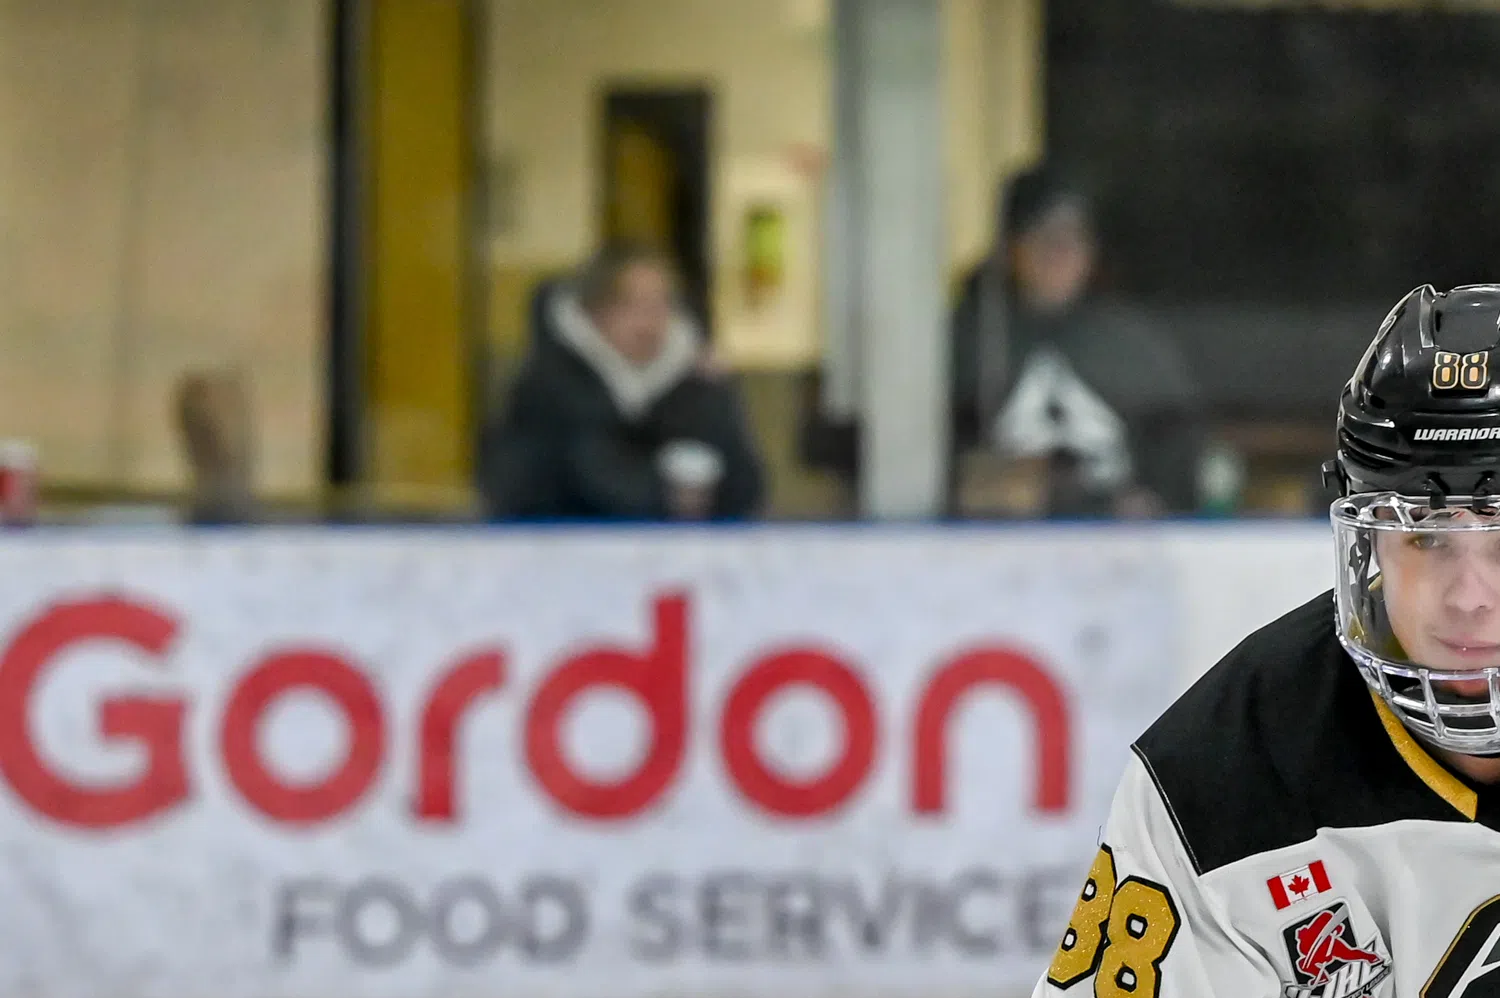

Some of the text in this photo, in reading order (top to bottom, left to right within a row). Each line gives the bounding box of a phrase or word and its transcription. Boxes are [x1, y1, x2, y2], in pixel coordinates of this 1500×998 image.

[1433, 351, 1489, 389] 88
[0, 588, 1075, 832] Gordon
[271, 872, 590, 966] FOOD
